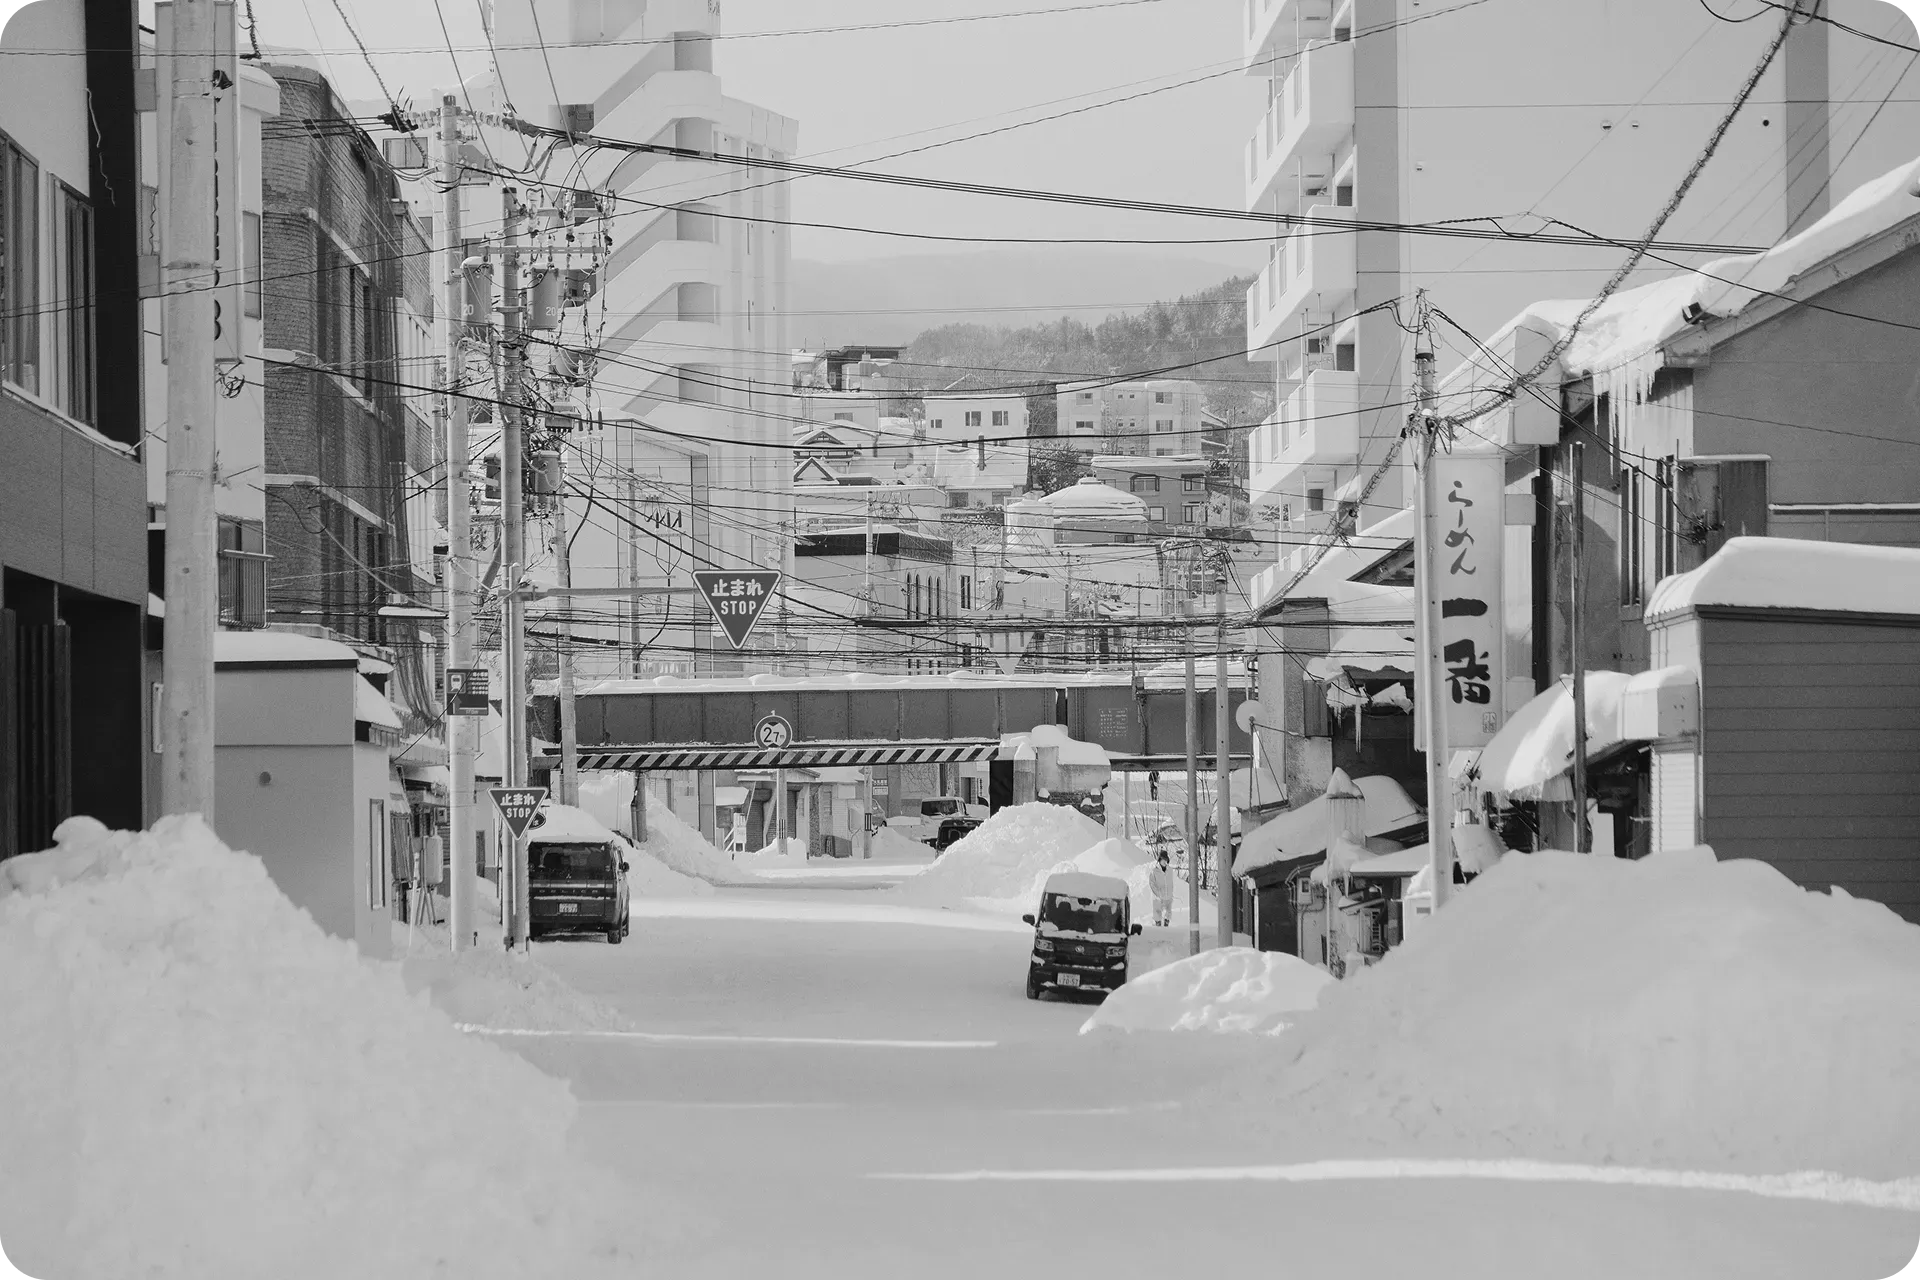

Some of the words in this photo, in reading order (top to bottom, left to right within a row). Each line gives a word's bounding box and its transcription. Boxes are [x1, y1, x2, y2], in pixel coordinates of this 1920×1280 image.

[545, 306, 557, 317] 20
[1444, 480, 1477, 575] らーめん
[711, 578, 764, 597] 止まれ
[720, 600, 757, 615] STOP
[500, 793, 536, 806] 止まれ
[506, 807, 531, 818] STOP
